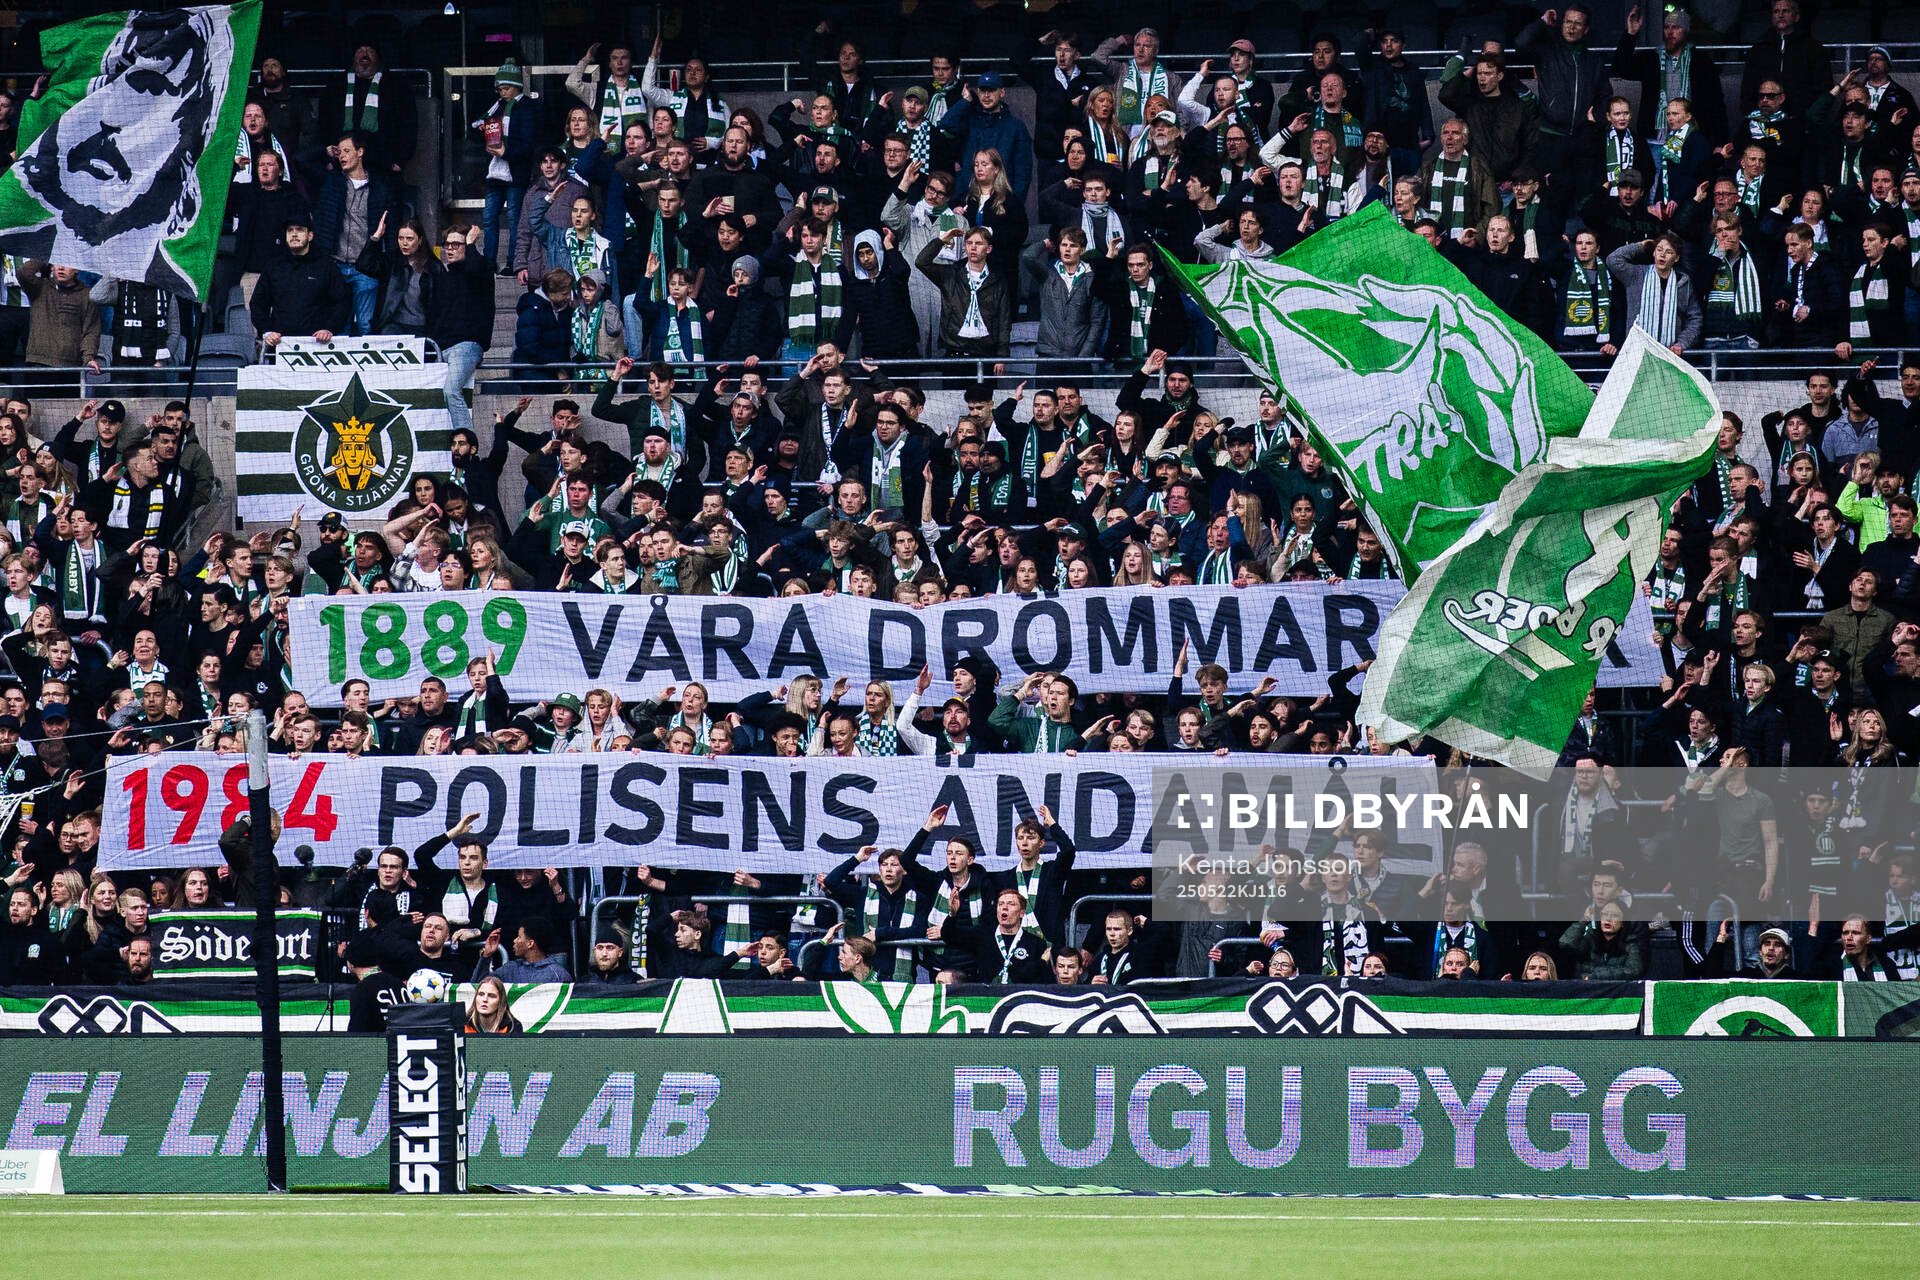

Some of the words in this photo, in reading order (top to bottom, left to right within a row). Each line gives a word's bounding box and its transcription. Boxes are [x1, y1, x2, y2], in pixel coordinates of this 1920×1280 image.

[300, 454, 337, 502] GRÖNA
[346, 454, 408, 506] STJÄRNAN
[320, 597, 528, 684] 1889
[562, 594, 829, 683] VÅRA
[869, 591, 1381, 682] DRÖMMAR
[378, 763, 880, 856] POLISENS
[926, 754, 1434, 862] ÄNDAMÅL
[6, 1072, 129, 1157] EL
[158, 1072, 553, 1157] LINJN
[559, 1072, 722, 1158] AB
[397, 1035, 440, 1193] SELECT
[454, 1033, 467, 1192] SELECT
[953, 1065, 1303, 1169] RUGU
[1348, 1065, 1687, 1172] BYGG
